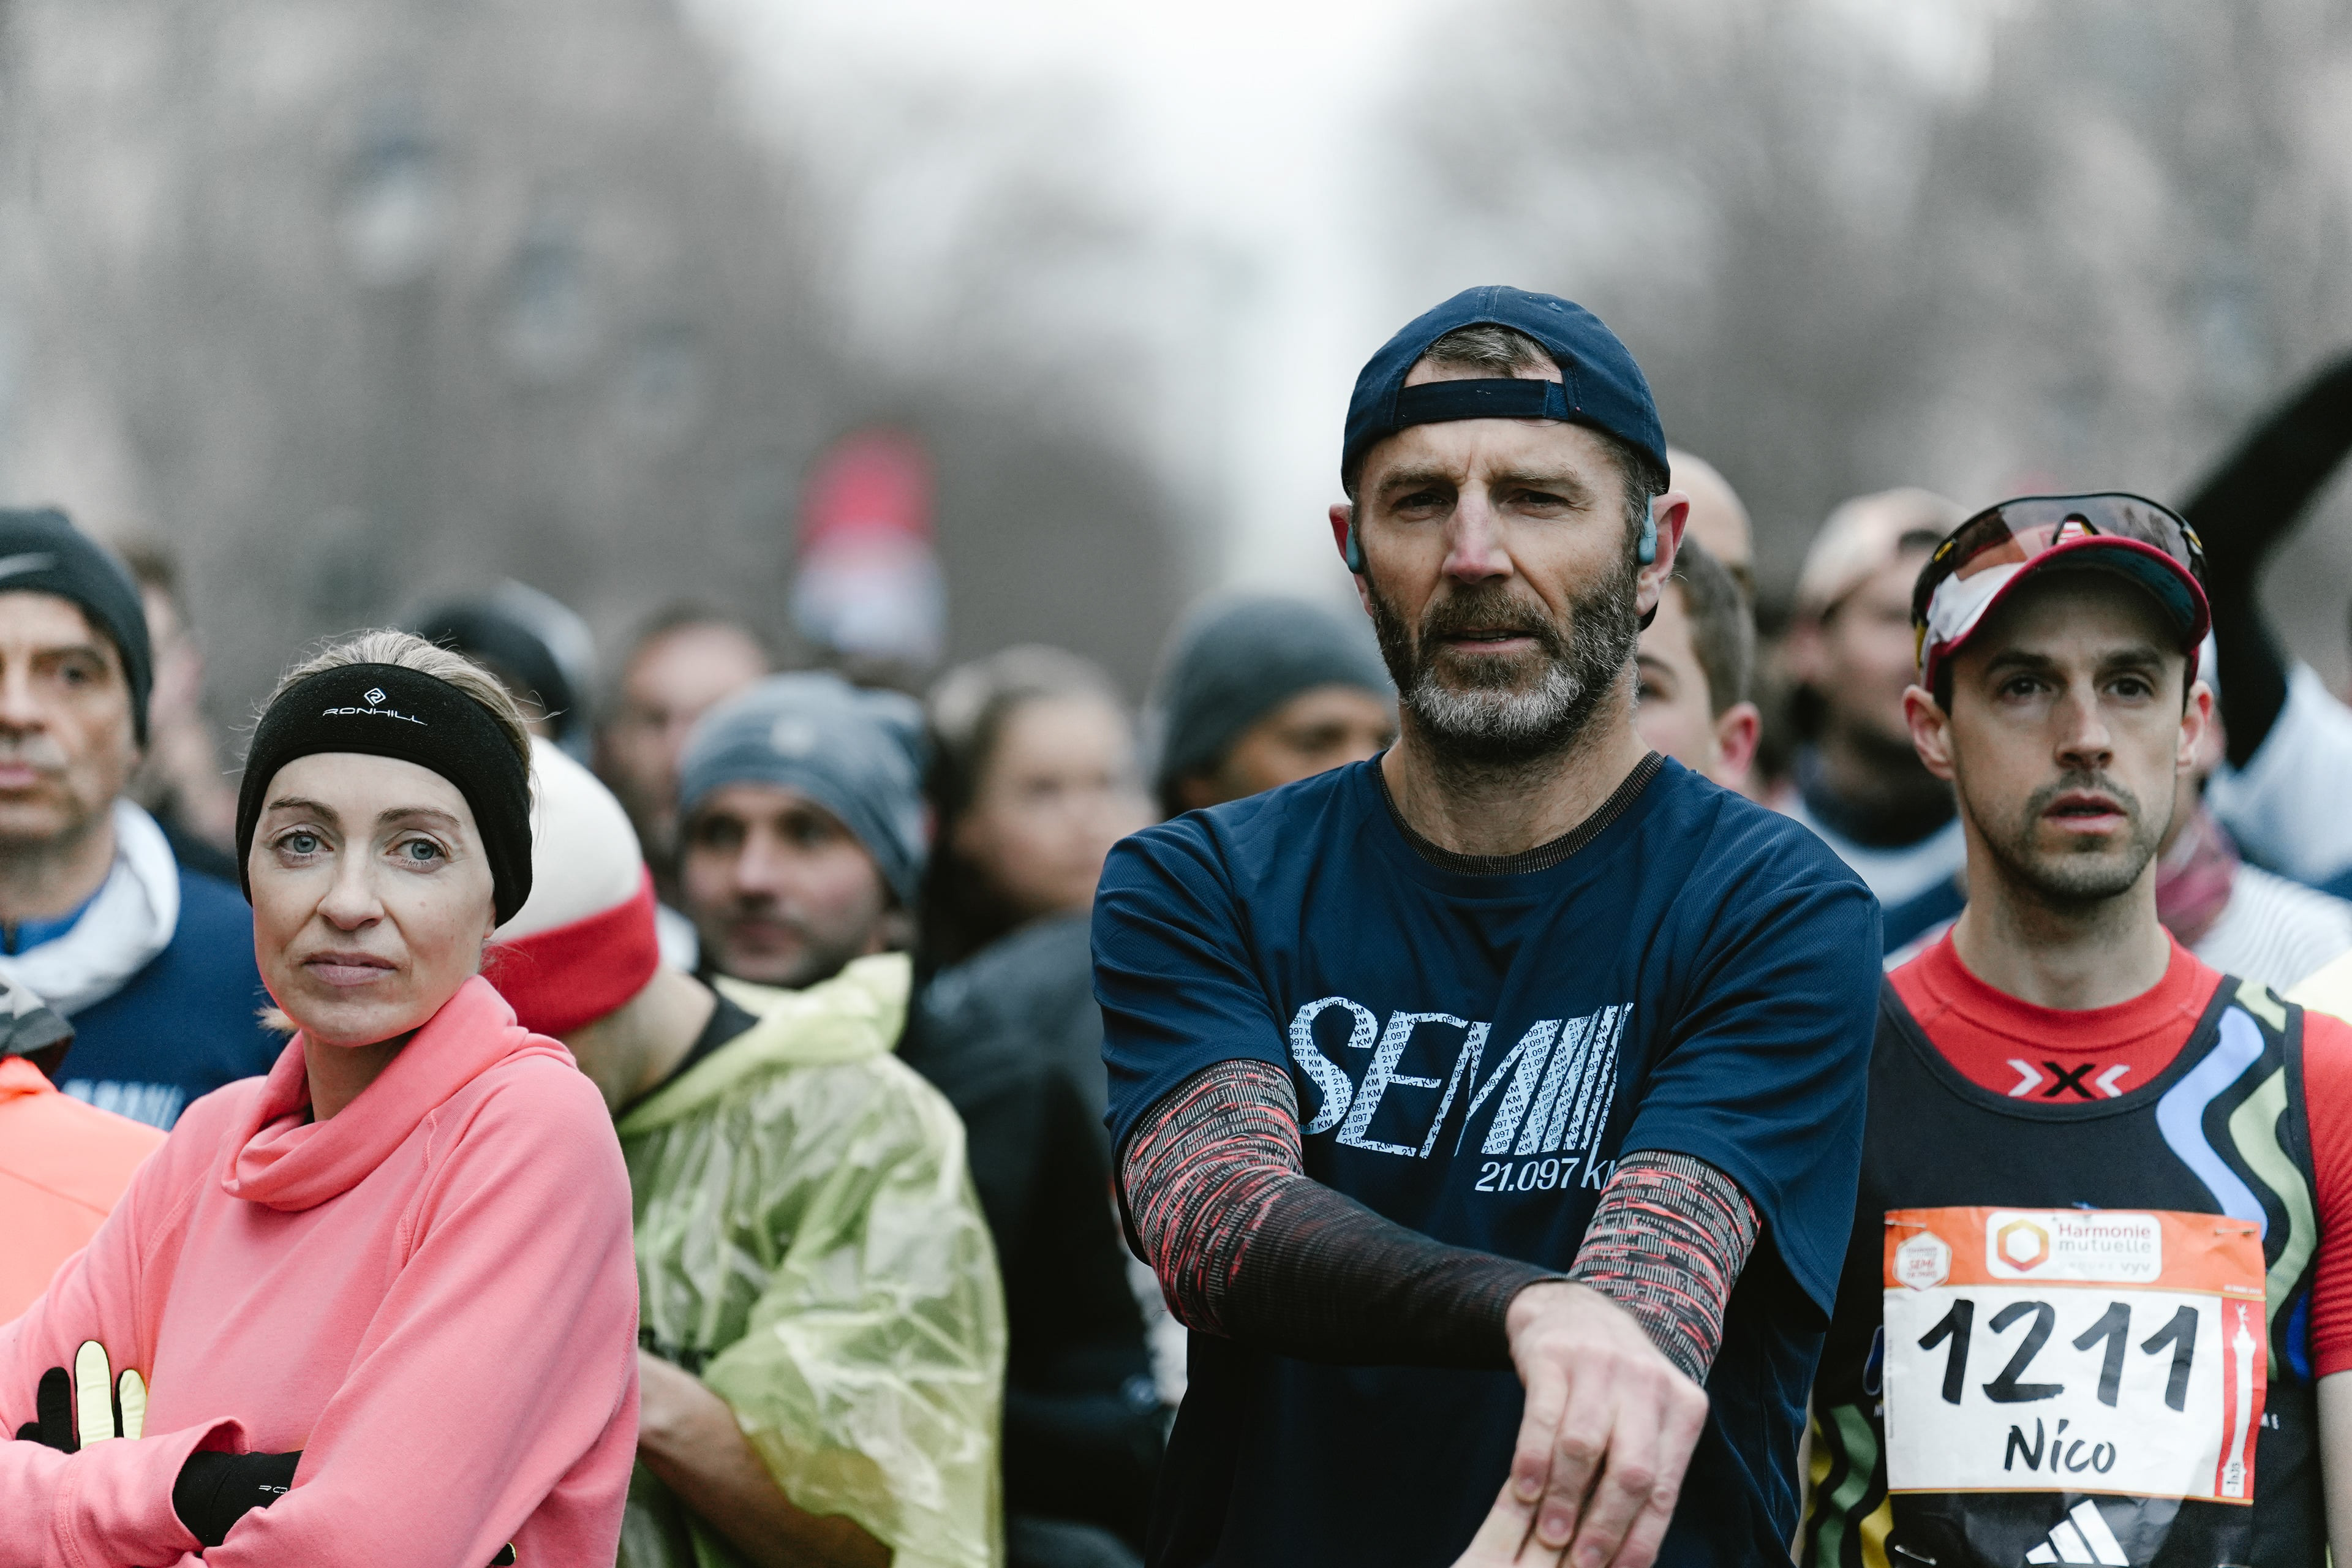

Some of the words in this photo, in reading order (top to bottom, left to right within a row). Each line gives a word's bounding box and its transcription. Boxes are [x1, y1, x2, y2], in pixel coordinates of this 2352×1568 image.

[322, 707, 428, 726] RONHILL
[1474, 1157, 1580, 1191] 21.097
[2059, 1223, 2151, 1238] Harmonie
[2059, 1238, 2152, 1254] mutuelle
[1918, 1298, 2199, 1412] 1211
[2003, 1417, 2117, 1474] Nico
